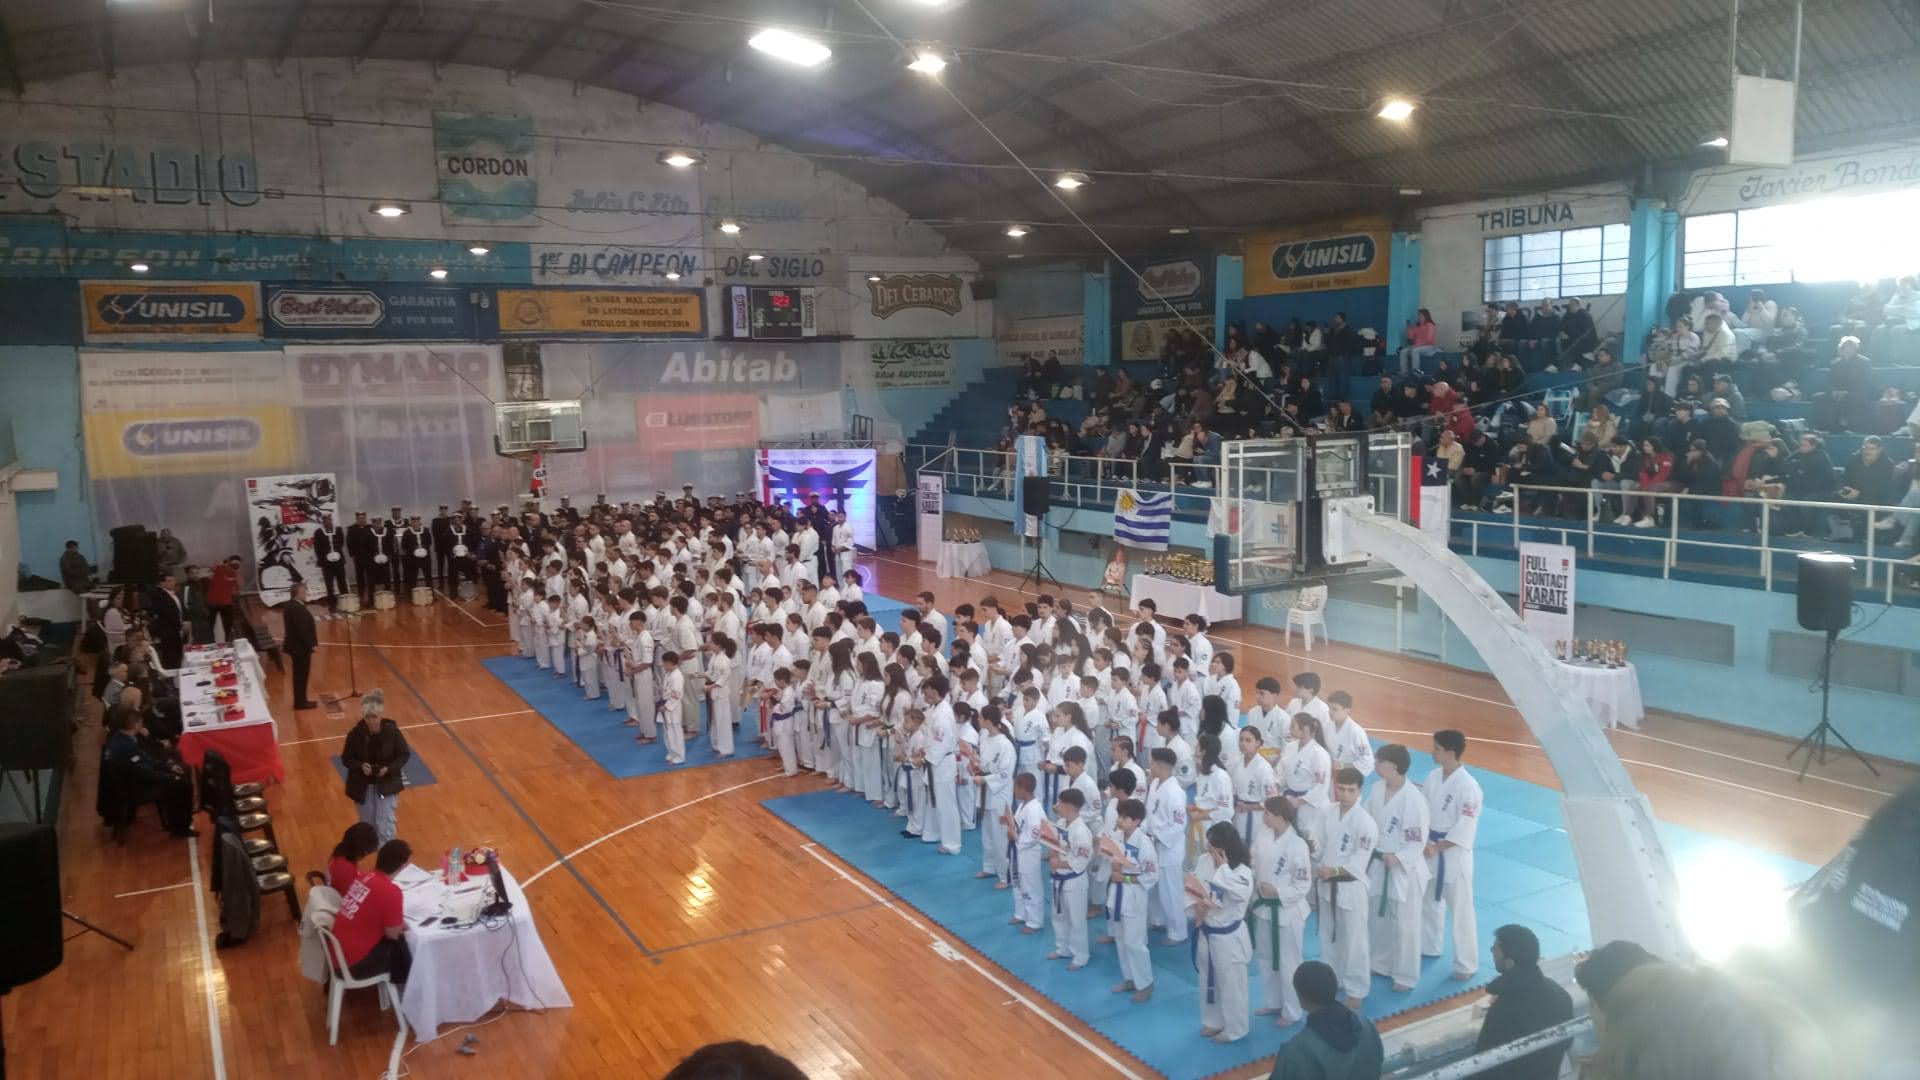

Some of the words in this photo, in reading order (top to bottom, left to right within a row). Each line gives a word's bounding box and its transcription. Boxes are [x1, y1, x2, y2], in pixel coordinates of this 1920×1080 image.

[447, 155, 528, 179] CORDON
[1477, 202, 1574, 232] TRIBUNA
[568, 252, 588, 276] BI
[724, 255, 760, 277] DEL
[767, 255, 824, 278] SIGLO
[1303, 243, 1367, 269] UNISIL
[139, 301, 232, 319] UNISIL
[658, 350, 798, 384] Abitab
[1526, 554, 1548, 572] FULL
[1525, 570, 1569, 590] CONTACT
[1525, 585, 1568, 608] KARATE
